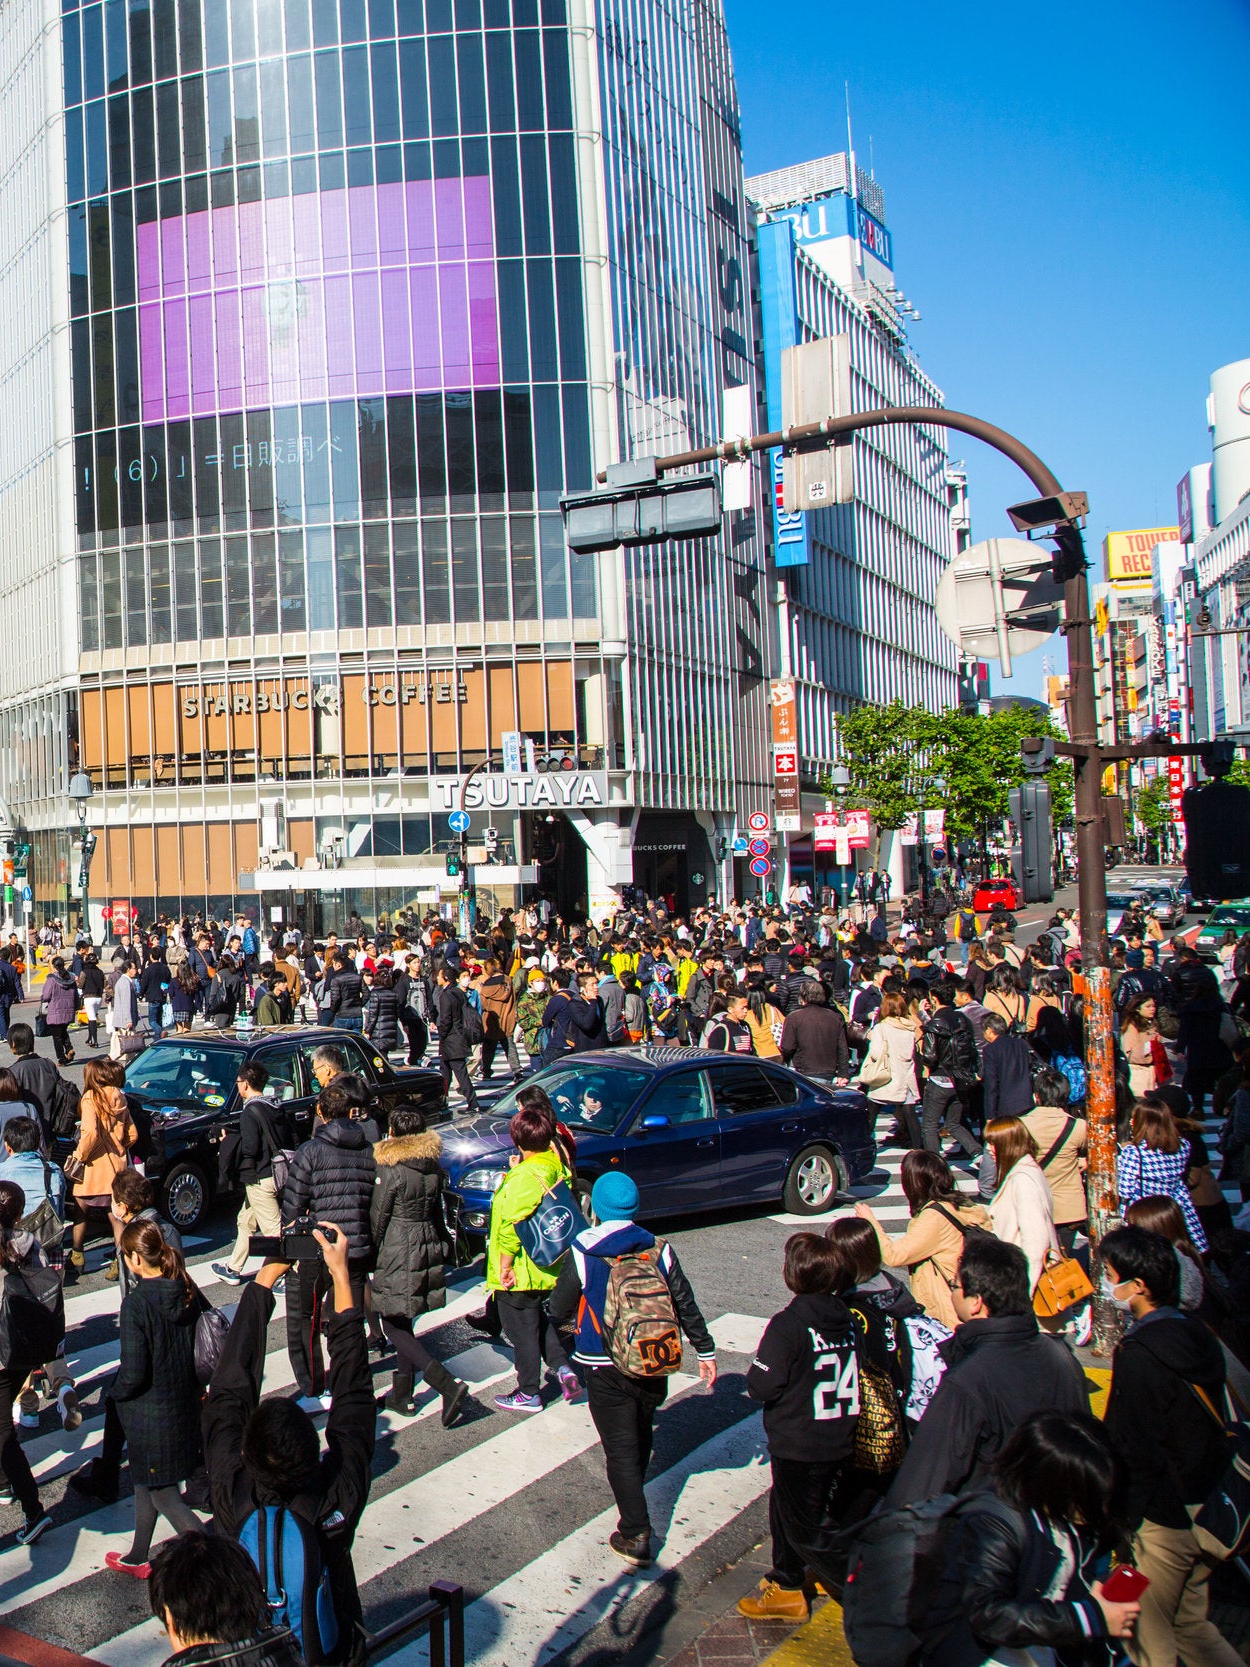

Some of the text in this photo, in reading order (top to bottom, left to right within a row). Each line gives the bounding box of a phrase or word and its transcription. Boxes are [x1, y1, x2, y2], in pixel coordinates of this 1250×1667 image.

[1151, 616, 1163, 678] KARAOKE
[183, 682, 468, 719] STARBUCKS COFFEE
[777, 755, 794, 772] 本
[436, 774, 602, 809] TSUTAYA
[543, 1211, 570, 1235] COACH
[638, 1327, 682, 1375] DC
[813, 1350, 861, 1421] 24
